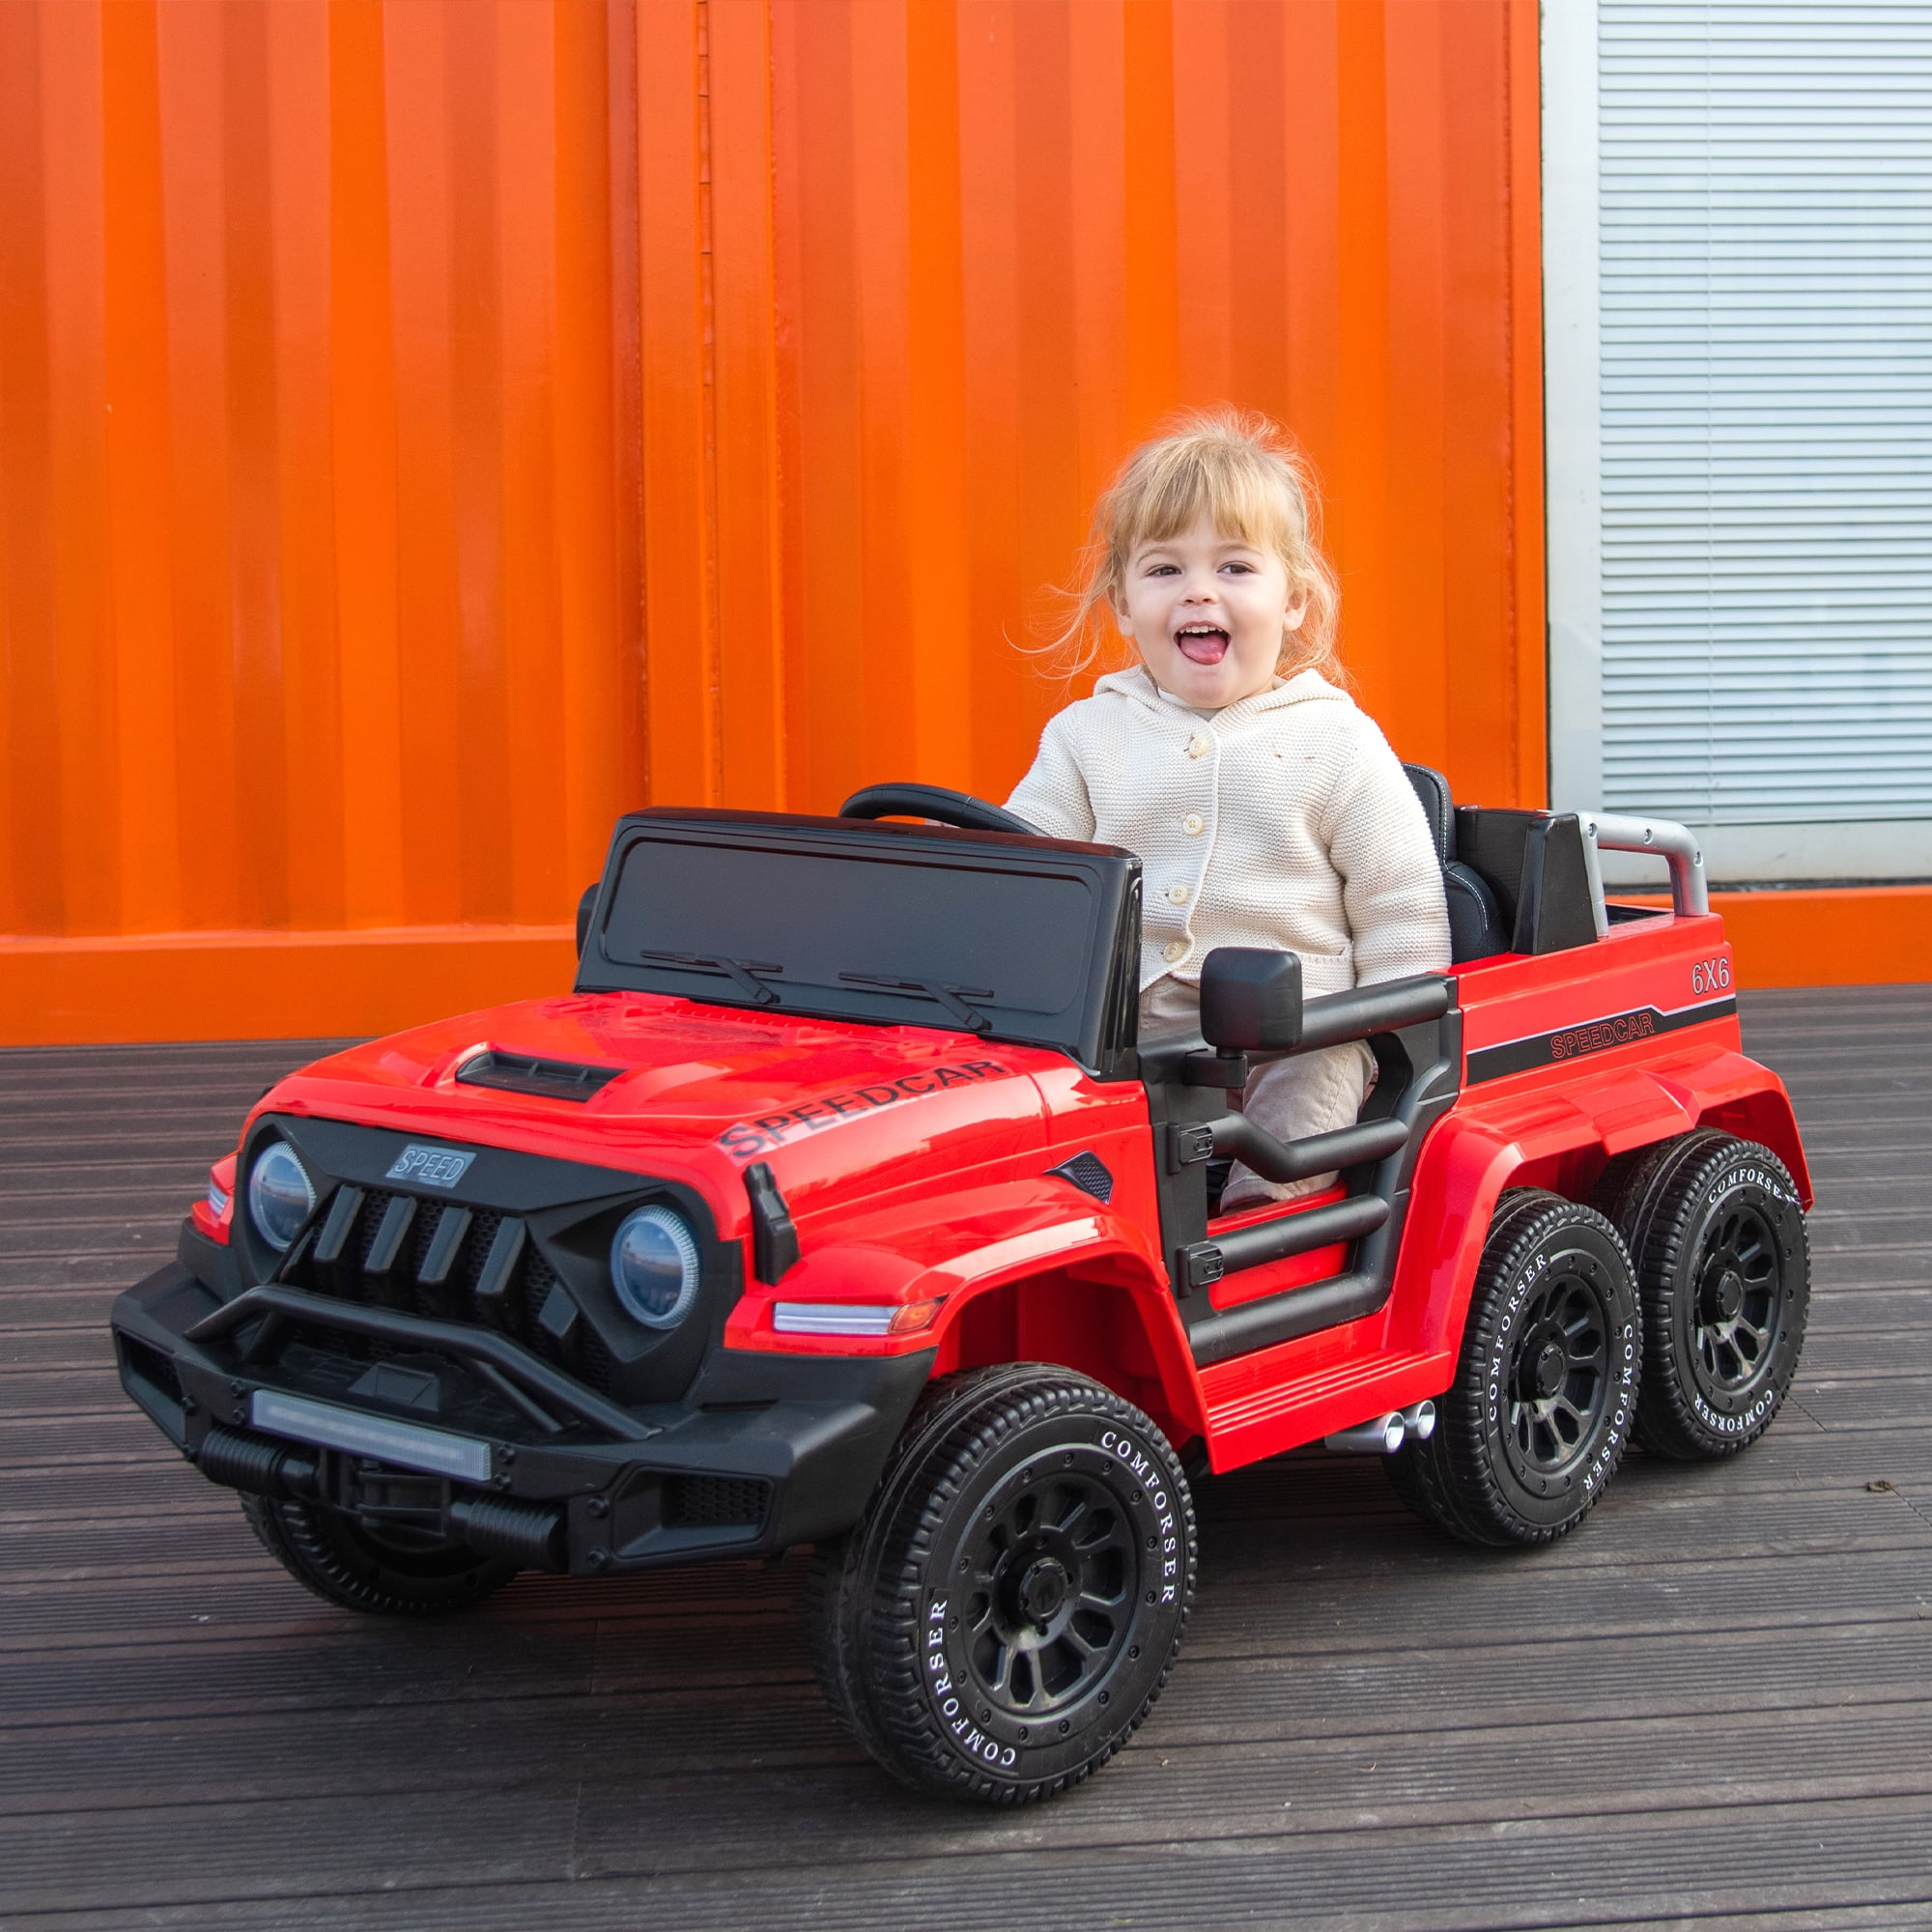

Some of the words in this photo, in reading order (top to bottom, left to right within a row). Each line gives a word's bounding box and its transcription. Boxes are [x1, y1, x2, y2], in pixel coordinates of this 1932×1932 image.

[1691, 956, 1730, 996] 6X6
[1549, 1012, 1656, 1060] SPEEDCAR
[719, 1060, 1006, 1158] SPEEDCAR
[394, 1150, 466, 1181] SPEED
[1489, 1253, 1548, 1423] COMFORSER
[1583, 1323, 1634, 1491] COMFORSER
[1694, 1389, 1774, 1433] COMFORSER
[1100, 1431, 1177, 1604] COMFORSER
[928, 1599, 1017, 1767] COMFORSER
